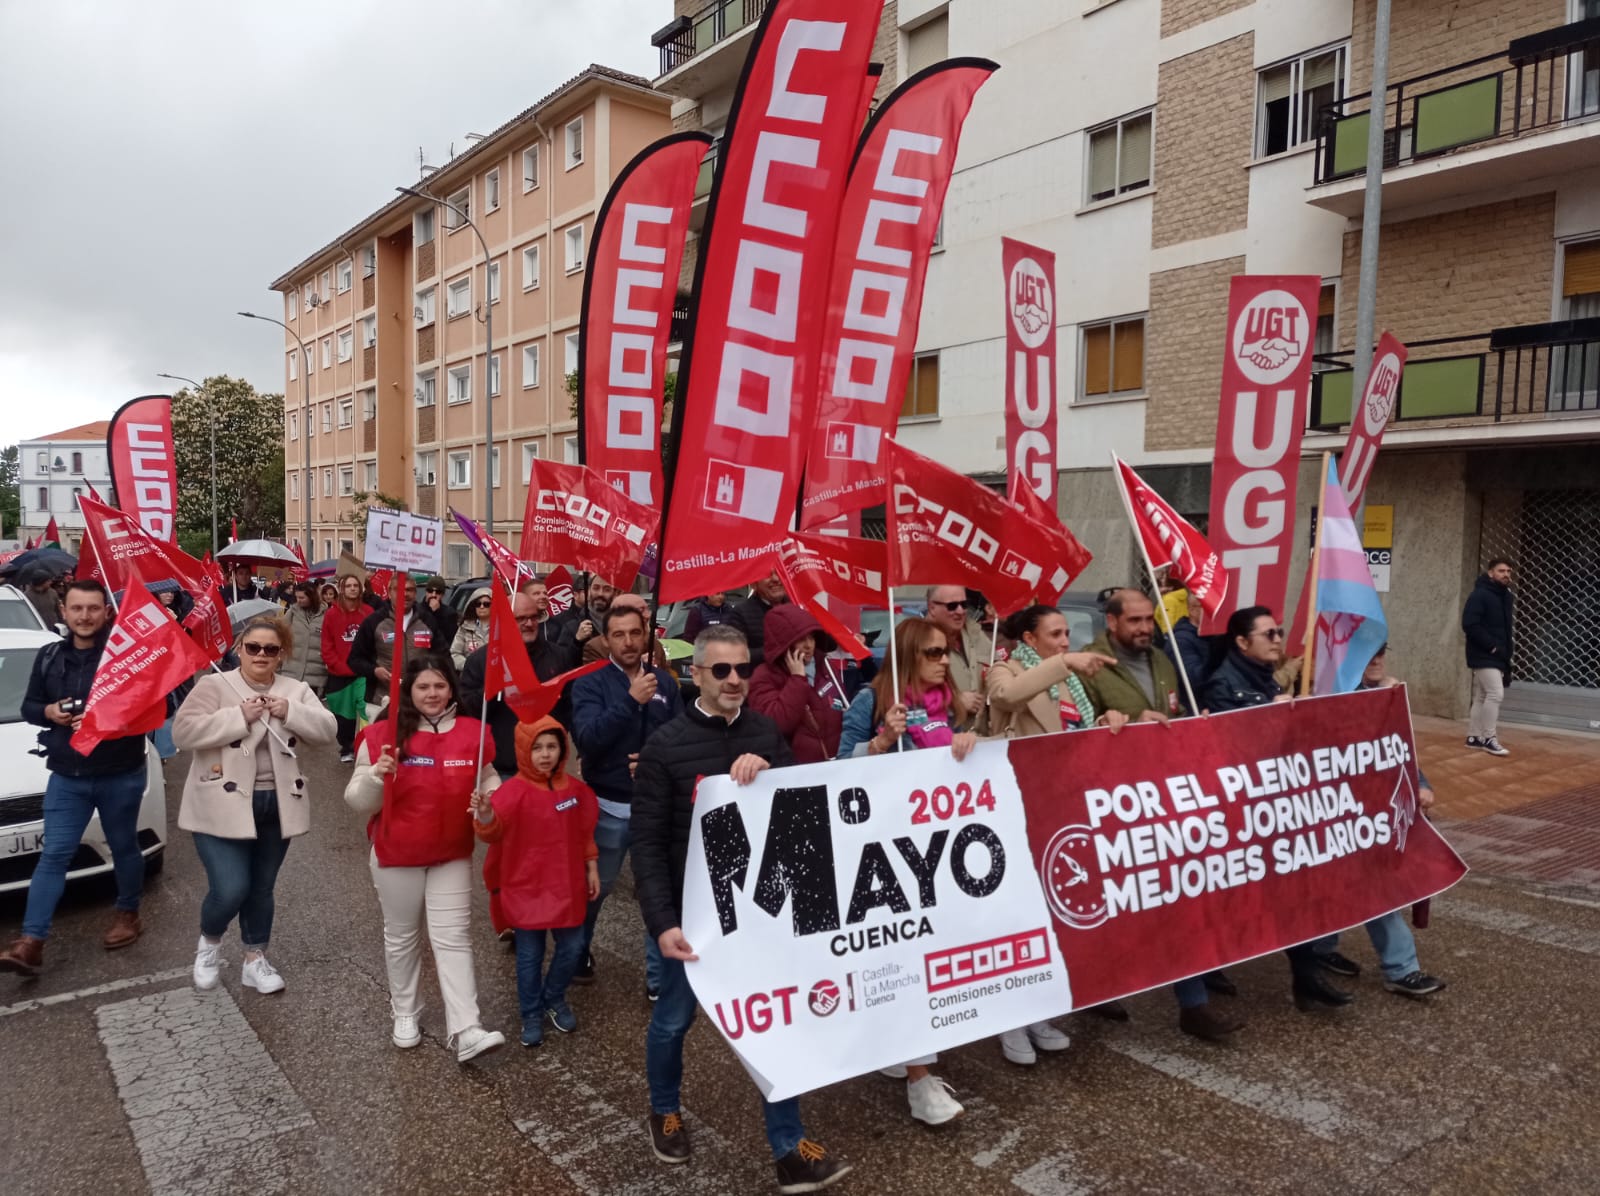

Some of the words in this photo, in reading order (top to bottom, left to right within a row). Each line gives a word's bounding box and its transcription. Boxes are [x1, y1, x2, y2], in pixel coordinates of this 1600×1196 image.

[714, 18, 848, 437] CCOO
[832, 129, 943, 404] CCOO
[1015, 271, 1046, 312] UGT
[606, 203, 674, 450] CCOO
[1243, 307, 1299, 341] UGT
[1013, 351, 1053, 501] UG
[126, 422, 172, 542] CCOO
[1222, 390, 1296, 611] UGT
[381, 520, 436, 546] CCOO
[665, 551, 735, 573] Castilla-La
[128, 645, 169, 675] Mancha
[908, 778, 997, 826] 2024
[1084, 779, 1167, 828] POR
[1165, 772, 1219, 813] EL
[1216, 753, 1312, 803] PLENO
[1093, 810, 1228, 874] MENOS
[1235, 782, 1364, 843] JORNADA,
[1102, 846, 1266, 919] MEJORES
[1271, 812, 1392, 875] SALARIOS
[829, 915, 935, 957] CUENCA
[863, 983, 878, 998] La
[879, 973, 921, 993] Mancha
[929, 940, 1014, 986] CCOO
[715, 986, 799, 1040] UGT
[865, 992, 896, 1008] Cuenca
[928, 982, 1002, 1011] Comisiones
[1004, 969, 1053, 991] Obreras
[930, 1007, 979, 1030] Cuenca
